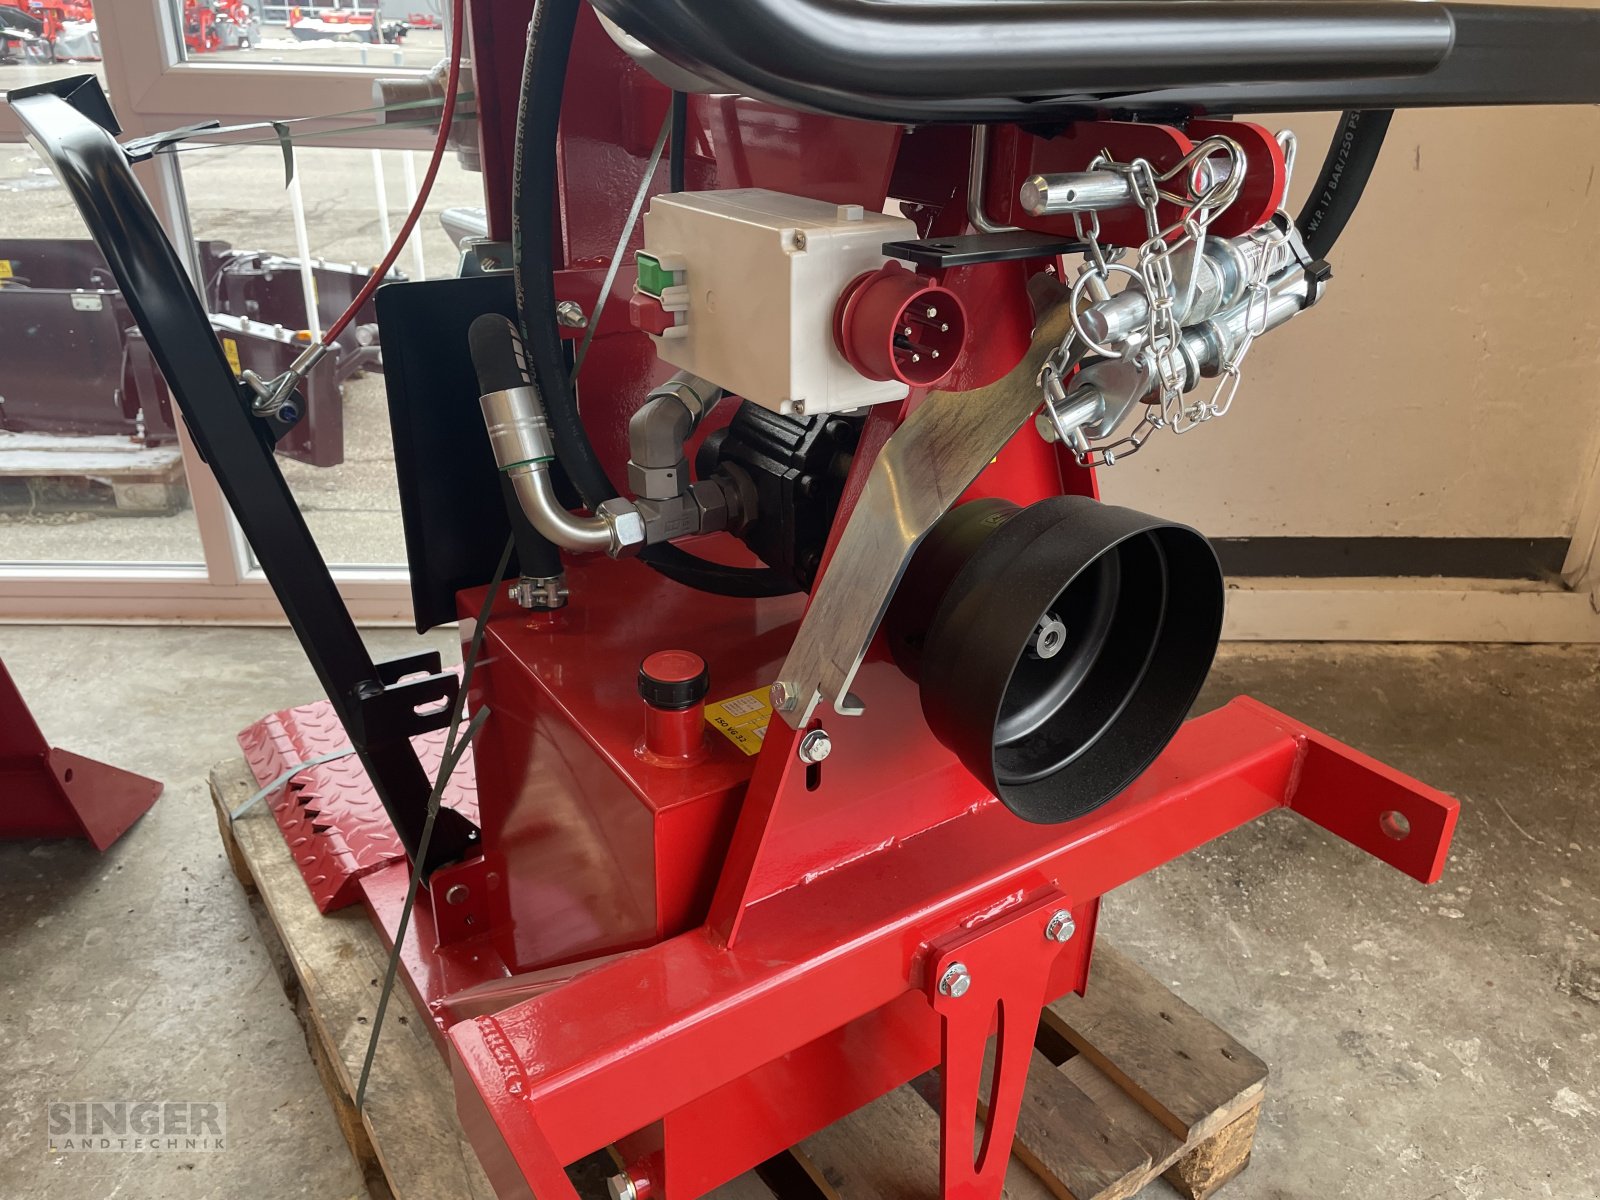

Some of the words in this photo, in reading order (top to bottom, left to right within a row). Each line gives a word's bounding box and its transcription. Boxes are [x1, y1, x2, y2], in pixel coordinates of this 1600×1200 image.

[519, 96, 528, 119] 853
[518, 121, 525, 139] EN
[514, 143, 523, 198] EXCEEDS
[1308, 210, 1325, 231] W.P.
[1321, 191, 1332, 207] 17
[1329, 133, 1354, 189] BAR/250
[714, 717, 728, 727] ISO
[727, 727, 738, 735] VG
